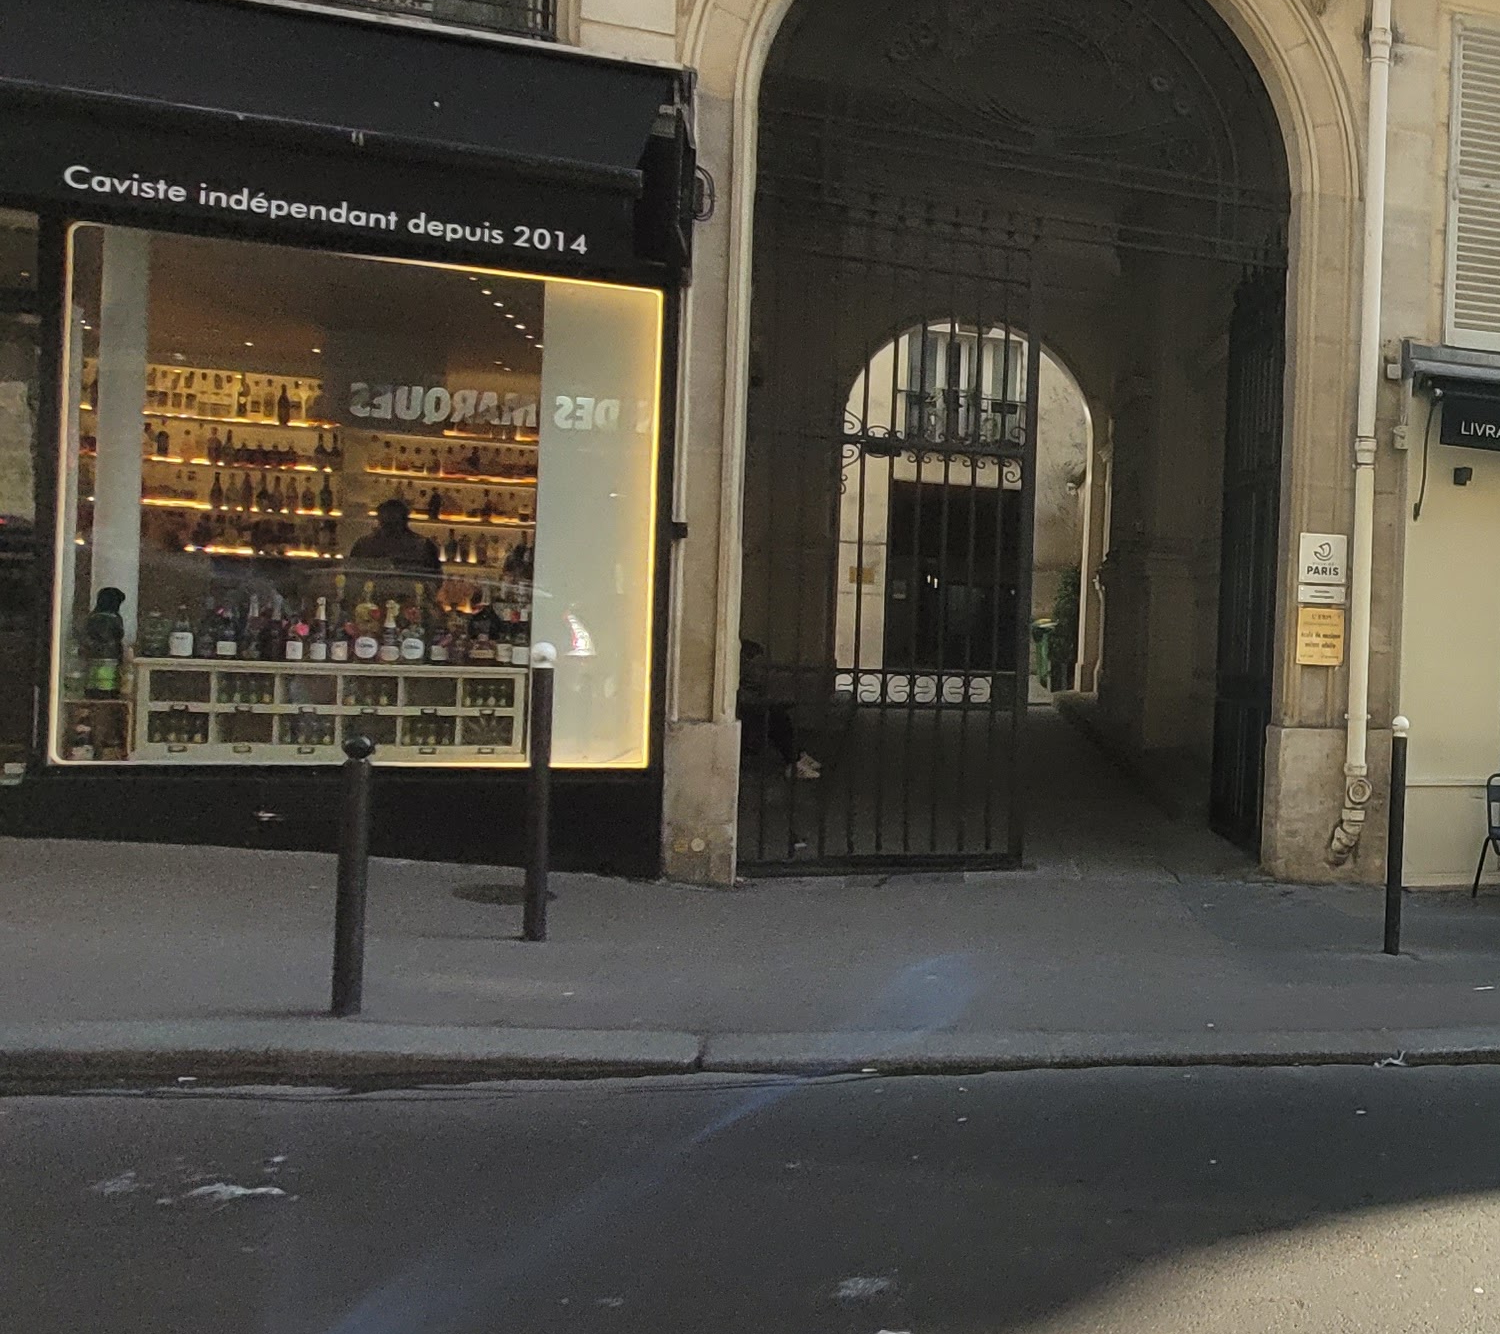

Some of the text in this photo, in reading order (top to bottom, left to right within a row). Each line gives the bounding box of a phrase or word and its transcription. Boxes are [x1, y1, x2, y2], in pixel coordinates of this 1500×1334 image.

[63, 164, 588, 255] Caviste indépendant depuis 2014
[1306, 565, 1339, 576] PARIS
